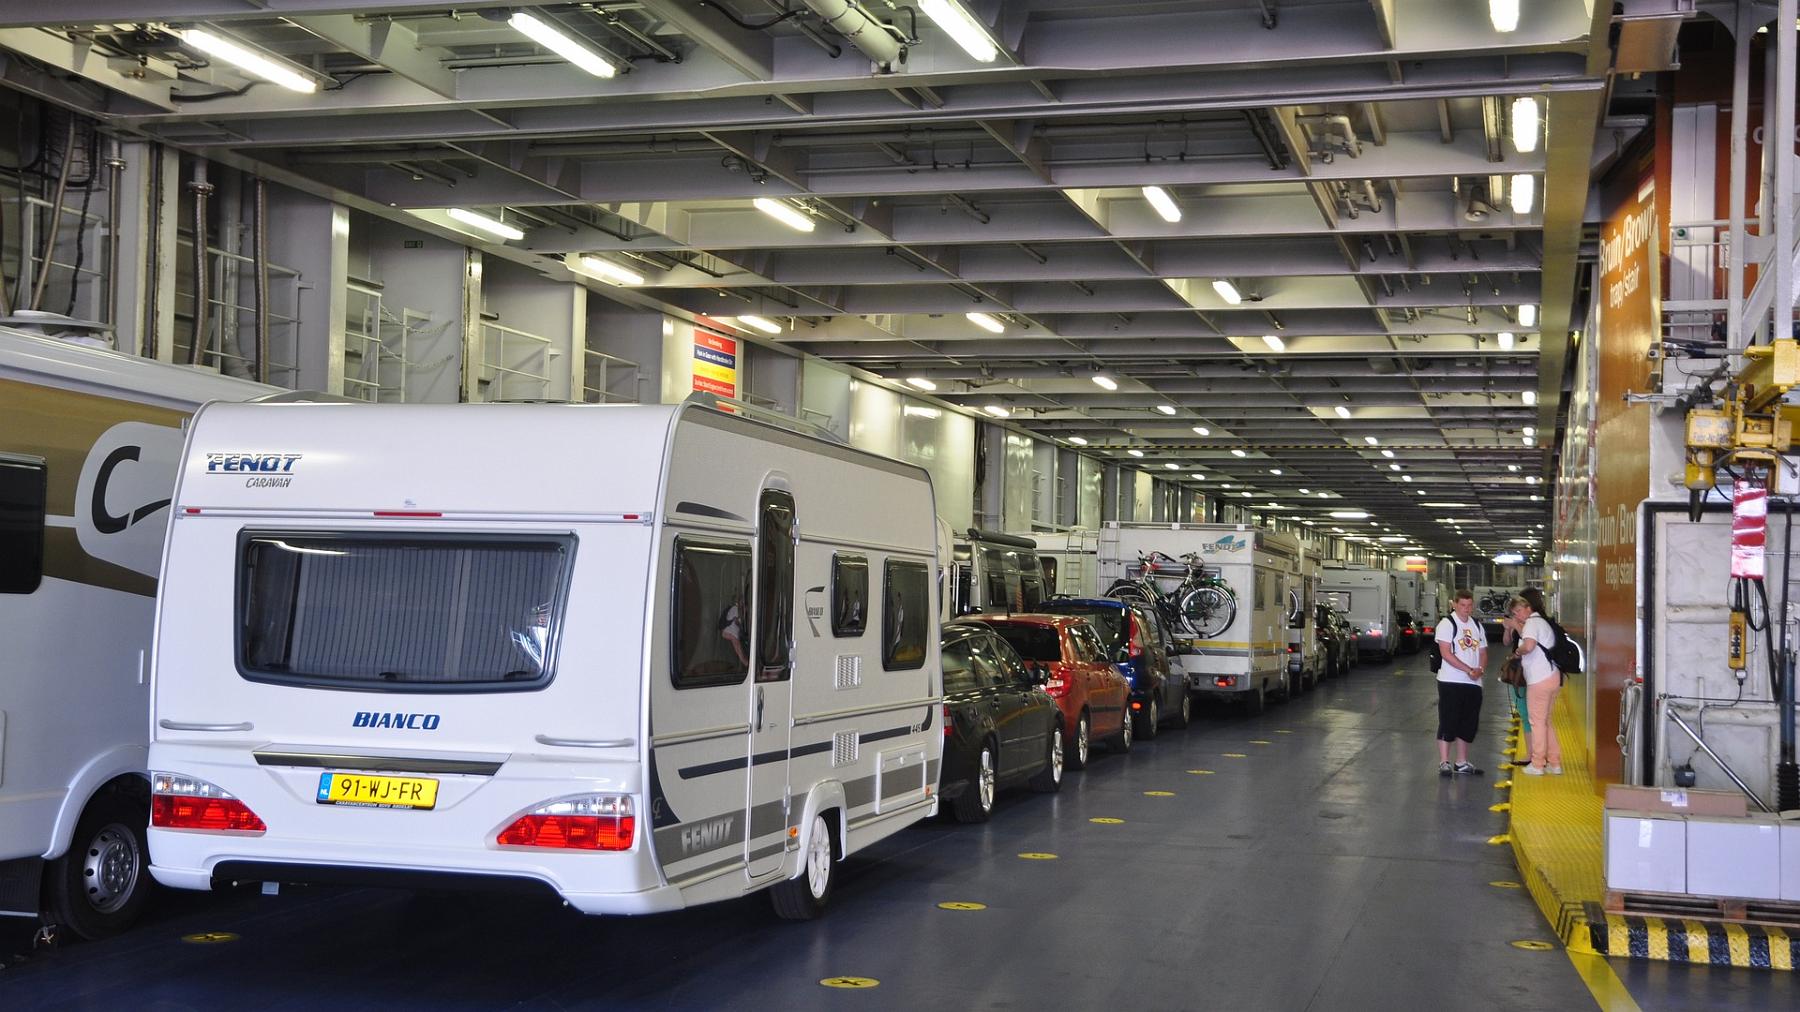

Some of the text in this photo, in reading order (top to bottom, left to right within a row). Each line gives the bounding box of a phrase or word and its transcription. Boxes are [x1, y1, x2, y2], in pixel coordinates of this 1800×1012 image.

[1610, 261, 1639, 309] trap/stair
[206, 453, 302, 472] FENDT
[245, 477, 292, 488] CARAVAN
[1597, 503, 1637, 554] ruin/Bro
[352, 711, 440, 730] BIANCO
[341, 778, 423, 801] 91-WJ-FR
[681, 816, 735, 856] FENDT
